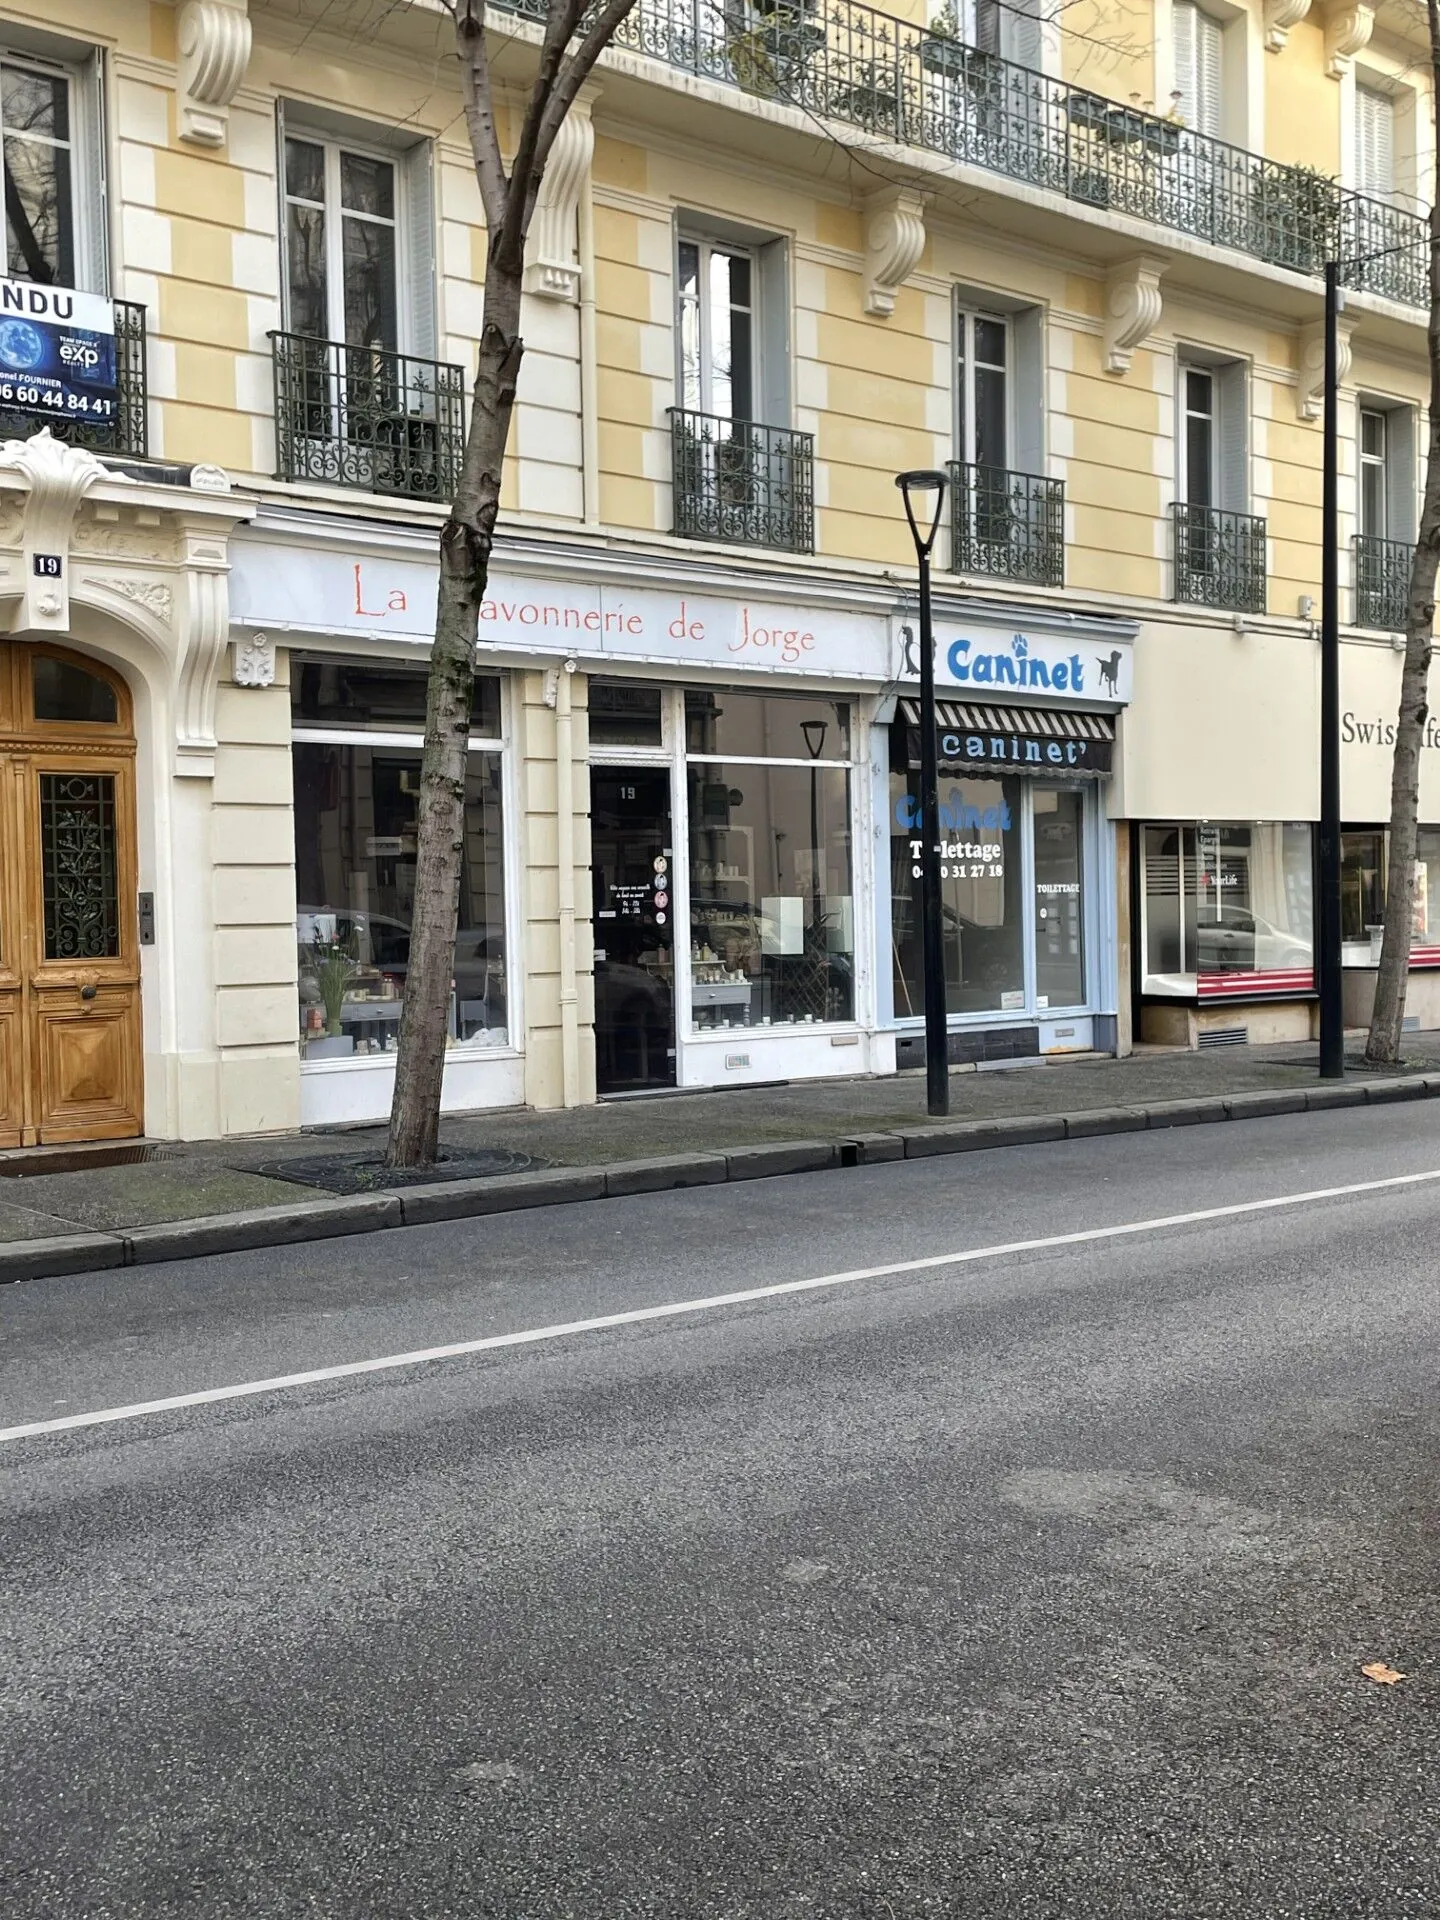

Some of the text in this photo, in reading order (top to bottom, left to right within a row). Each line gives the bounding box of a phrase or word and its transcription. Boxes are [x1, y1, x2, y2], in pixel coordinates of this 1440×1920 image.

[19, 374, 62, 388] FOURNIER
[0, 383, 13, 400] 6
[16, 385, 38, 404] 60
[42, 390, 64, 408] 44
[67, 394, 89, 412] 84
[92, 398, 111, 416] 41
[39, 557, 58, 574] 19
[354, 563, 816, 663] La avonnerie de Jorge
[947, 639, 1084, 693] Caninet
[620, 786, 636, 800] 19
[909, 840, 1001, 862] Tlettage
[952, 865, 967, 878] 31
[970, 865, 985, 878] 27
[988, 864, 1003, 877] 18
[1036, 883, 1080, 894] TOILETTAGE
